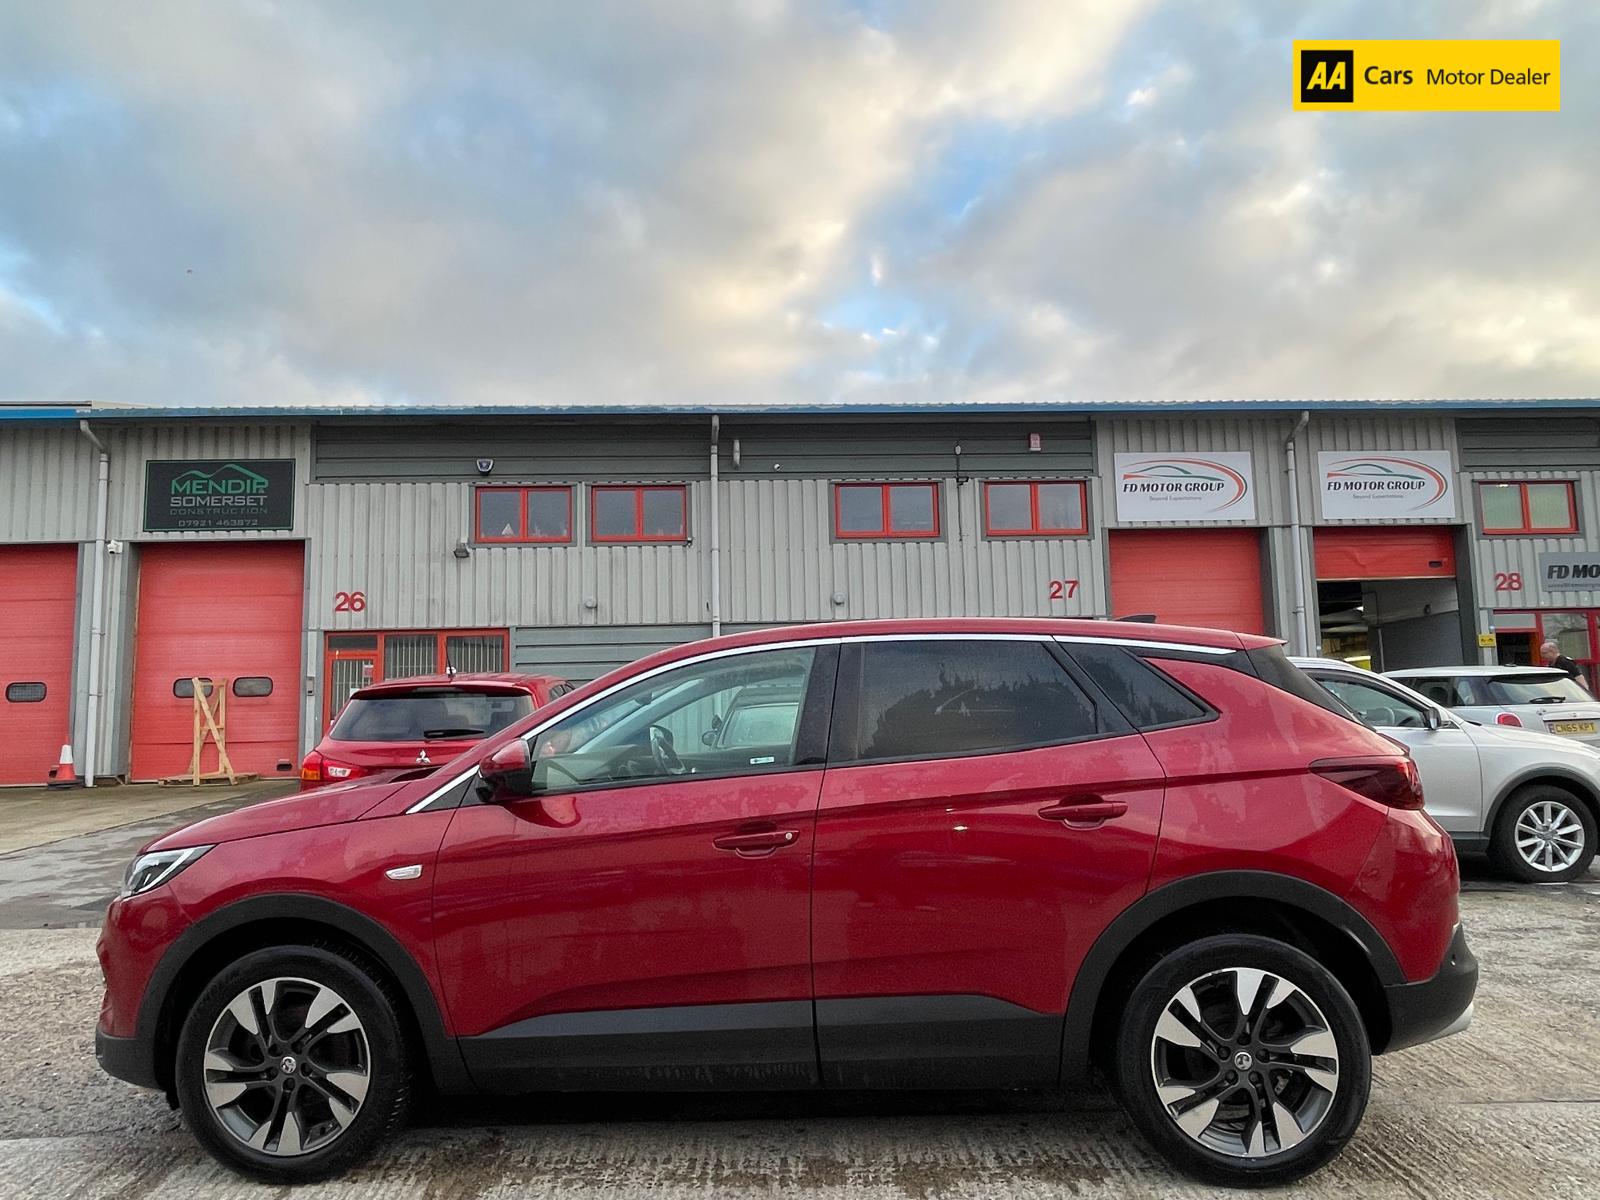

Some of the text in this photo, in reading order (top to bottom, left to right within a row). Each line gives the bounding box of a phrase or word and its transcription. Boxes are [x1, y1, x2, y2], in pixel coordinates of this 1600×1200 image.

[171, 479, 269, 495] MENDIP
[1123, 482, 1225, 493] FD MOTOR GROUP
[1327, 480, 1425, 491] FD MOTOR GROUP
[170, 495, 268, 507] SOMERSET
[169, 507, 268, 516] CONSTRUCTION
[1547, 564, 1600, 579] FD MO
[1049, 580, 1080, 599] 27
[1495, 573, 1523, 591] 28
[335, 591, 366, 612] 26
